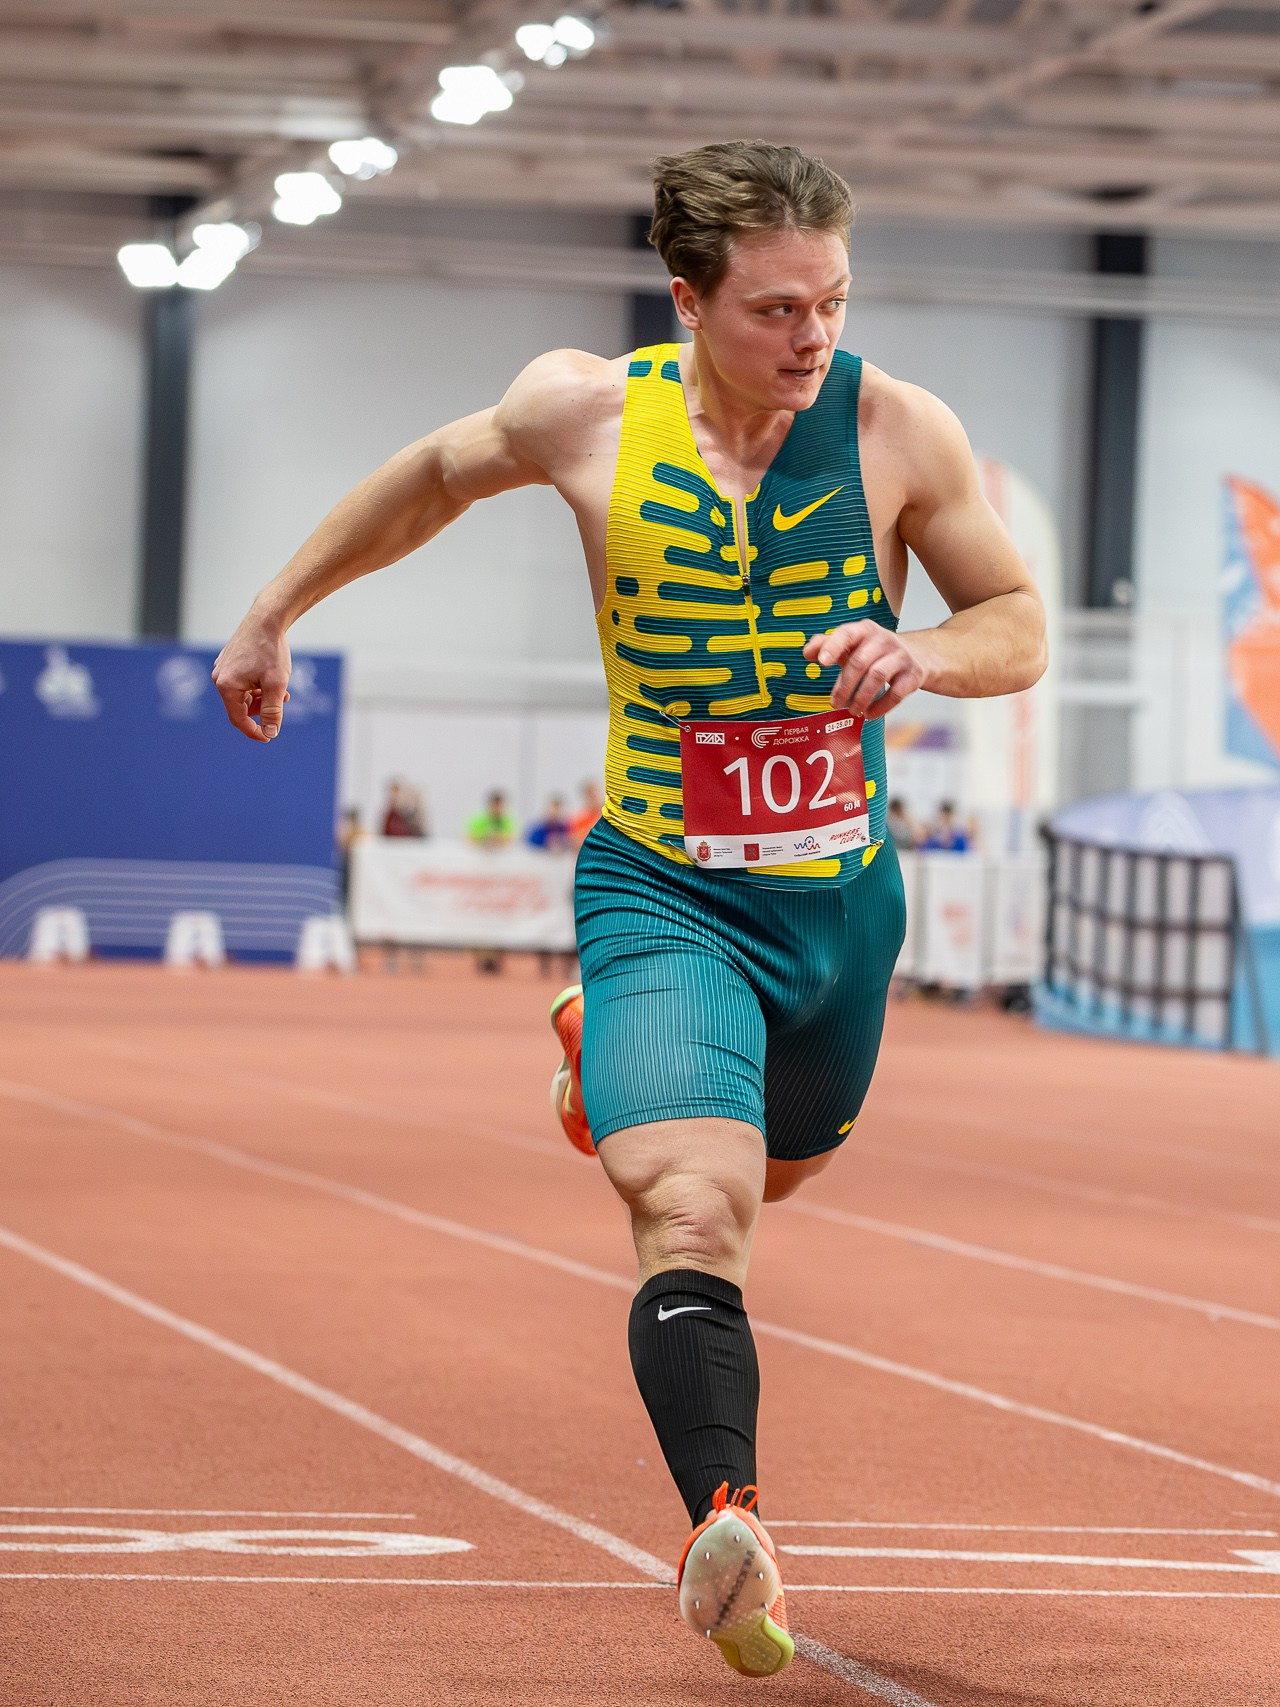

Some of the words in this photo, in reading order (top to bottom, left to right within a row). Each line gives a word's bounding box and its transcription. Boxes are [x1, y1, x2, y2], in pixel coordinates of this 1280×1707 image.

[784, 726, 809, 736] ПЕРВАЯ
[773, 735, 810, 746] ДОРОЖКА
[723, 749, 837, 816] 102
[844, 802, 853, 812] 60
